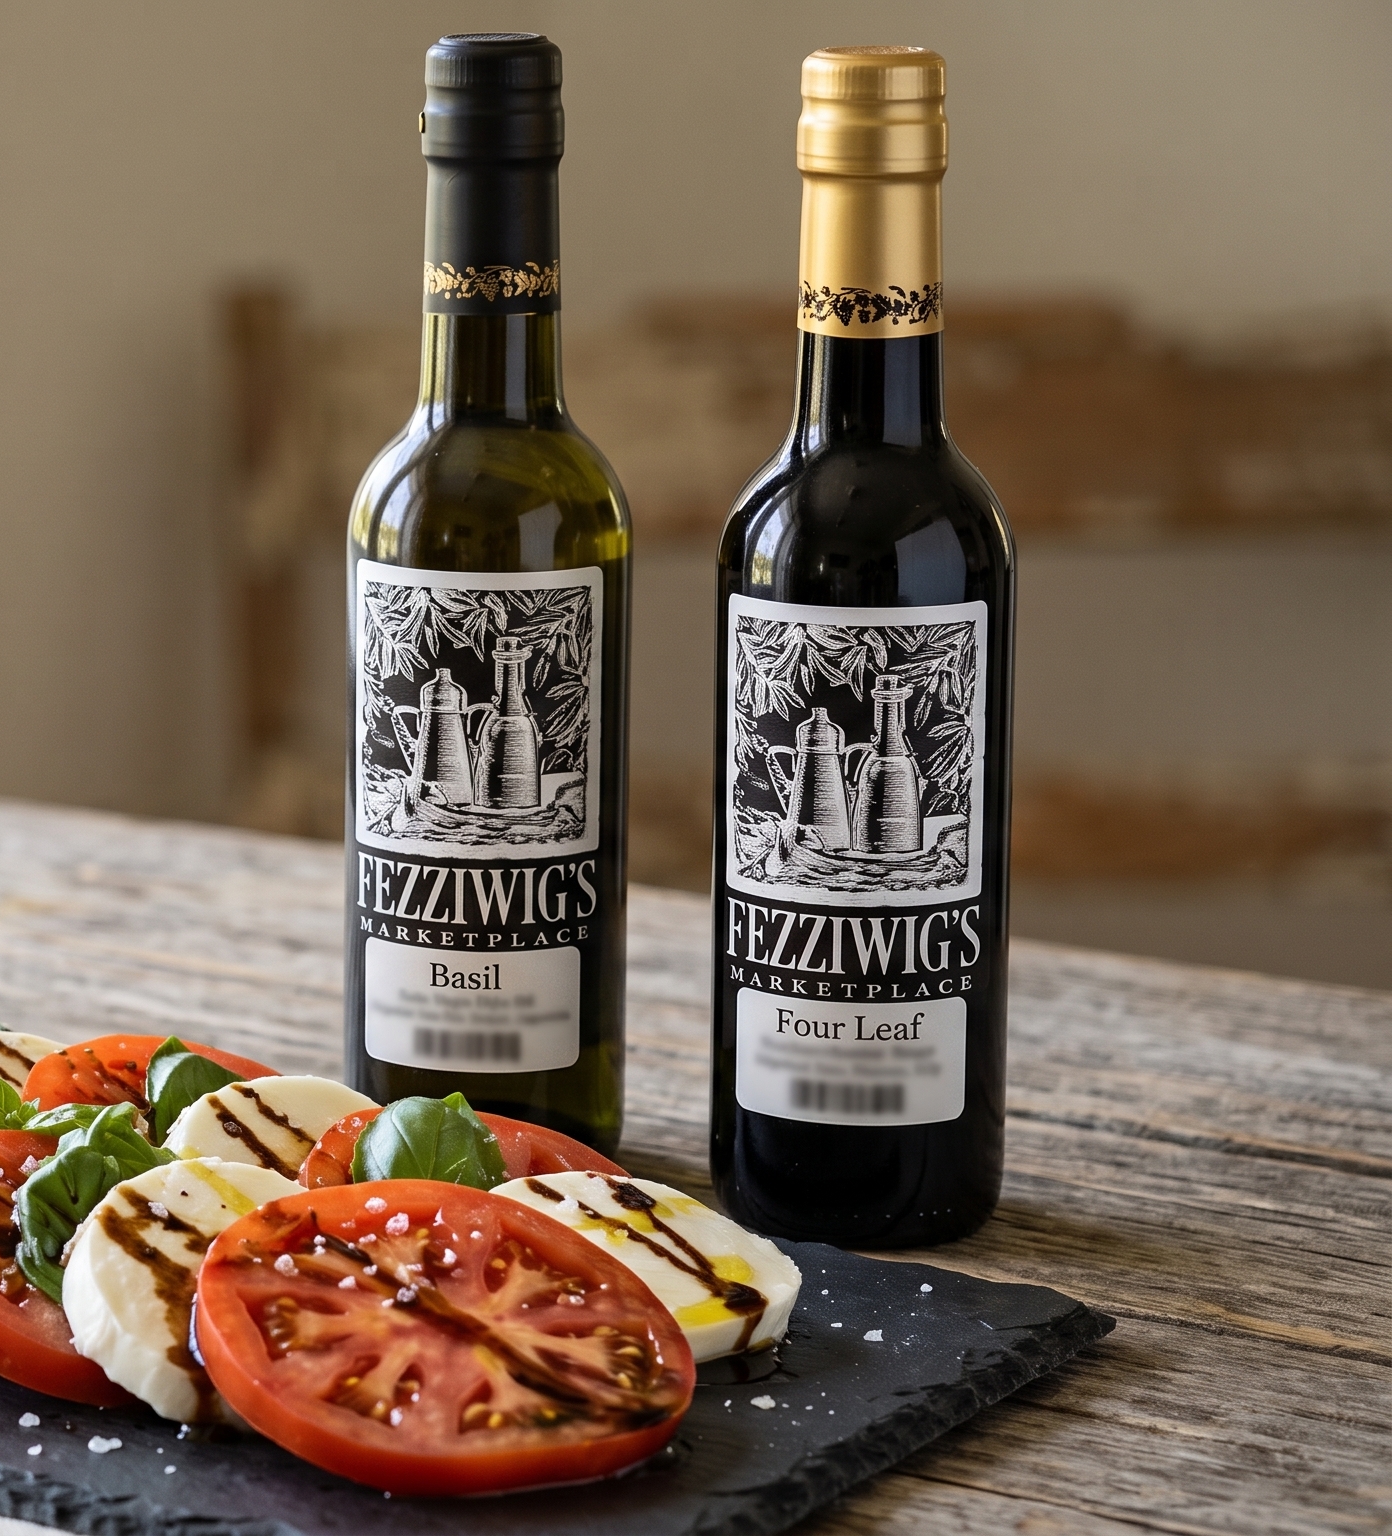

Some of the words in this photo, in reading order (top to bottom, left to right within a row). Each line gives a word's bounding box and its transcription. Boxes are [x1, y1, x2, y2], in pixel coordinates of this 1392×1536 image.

[357, 851, 597, 926] FEZZIWIG'S
[360, 915, 589, 948] MARKETPLACE
[726, 896, 981, 976] FEZZIWIG'S
[429, 962, 502, 990] Basil
[730, 964, 972, 999] MARKETPLACE
[776, 1008, 846, 1040] Four
[854, 1012, 925, 1041] Leaf
